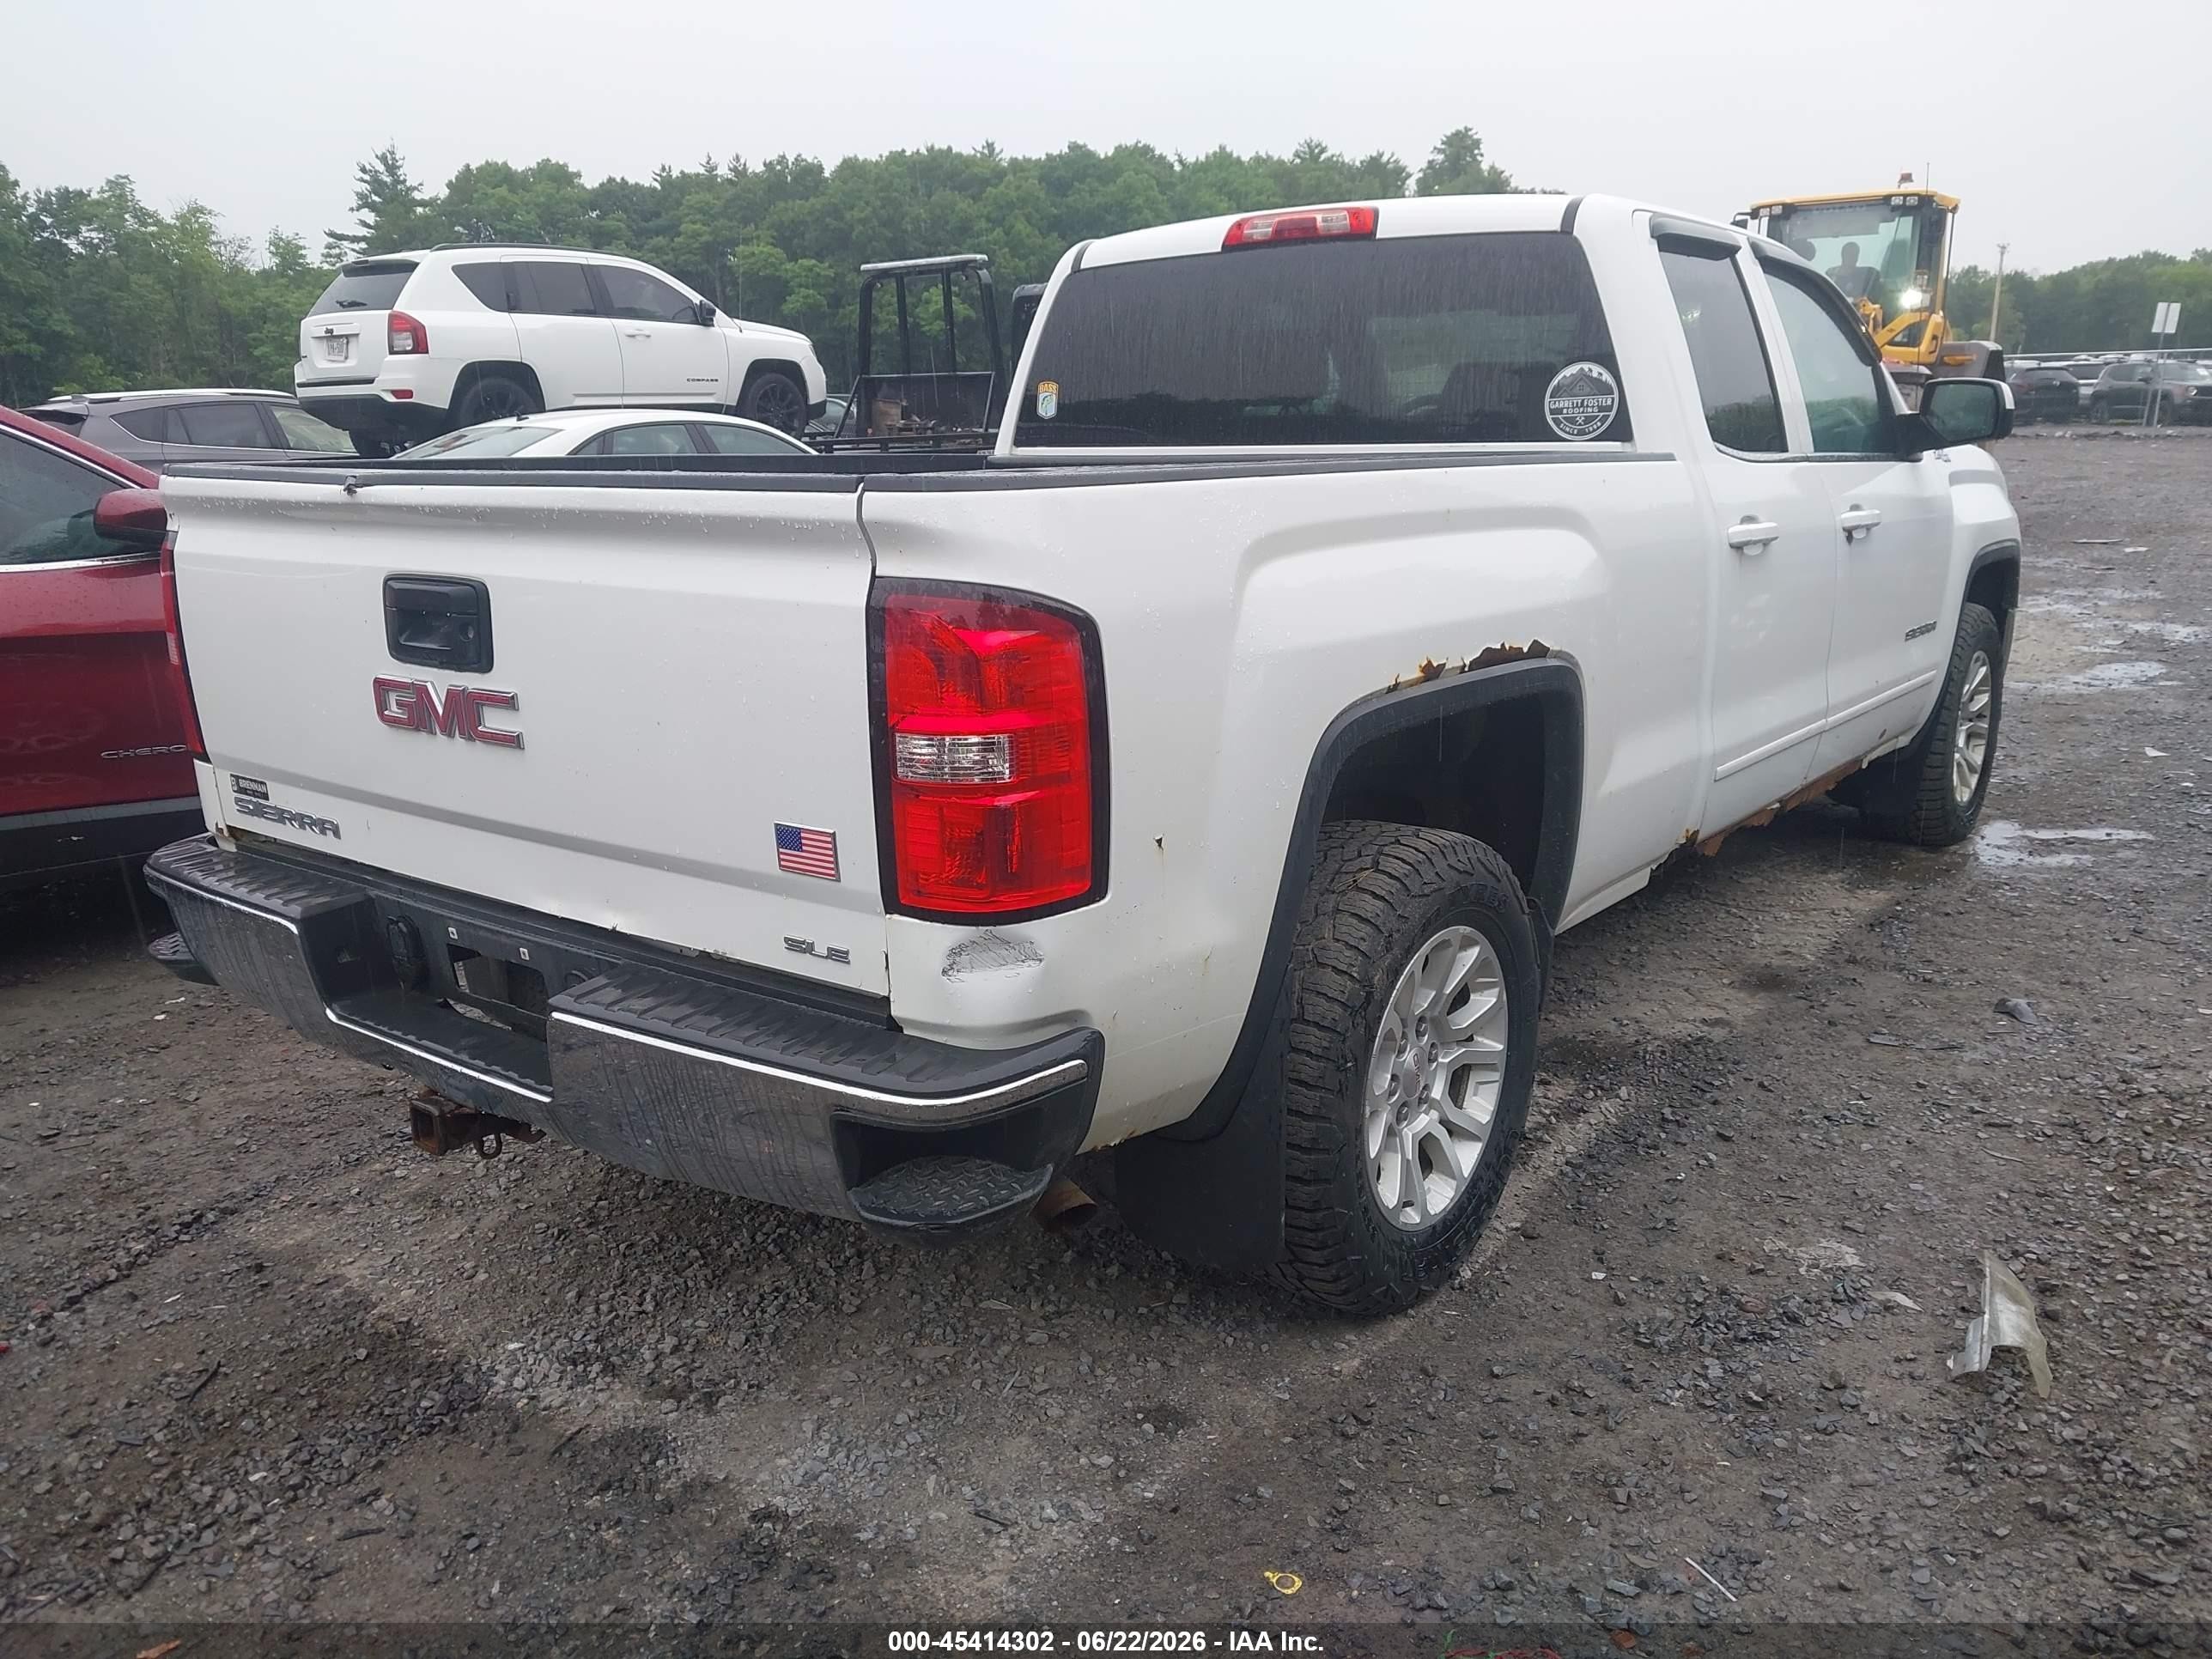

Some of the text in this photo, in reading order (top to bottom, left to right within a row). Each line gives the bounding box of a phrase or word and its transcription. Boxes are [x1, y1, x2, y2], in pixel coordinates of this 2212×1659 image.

[1039, 383, 1057, 393] BASS
[1549, 398, 1613, 410] GARRETT FOSTER
[1559, 422, 1578, 434] SINCE
[372, 674, 526, 750] GMC
[238, 778, 267, 794] BRENNAN
[234, 795, 342, 840] SIERRA
[783, 933, 851, 965] SLE
